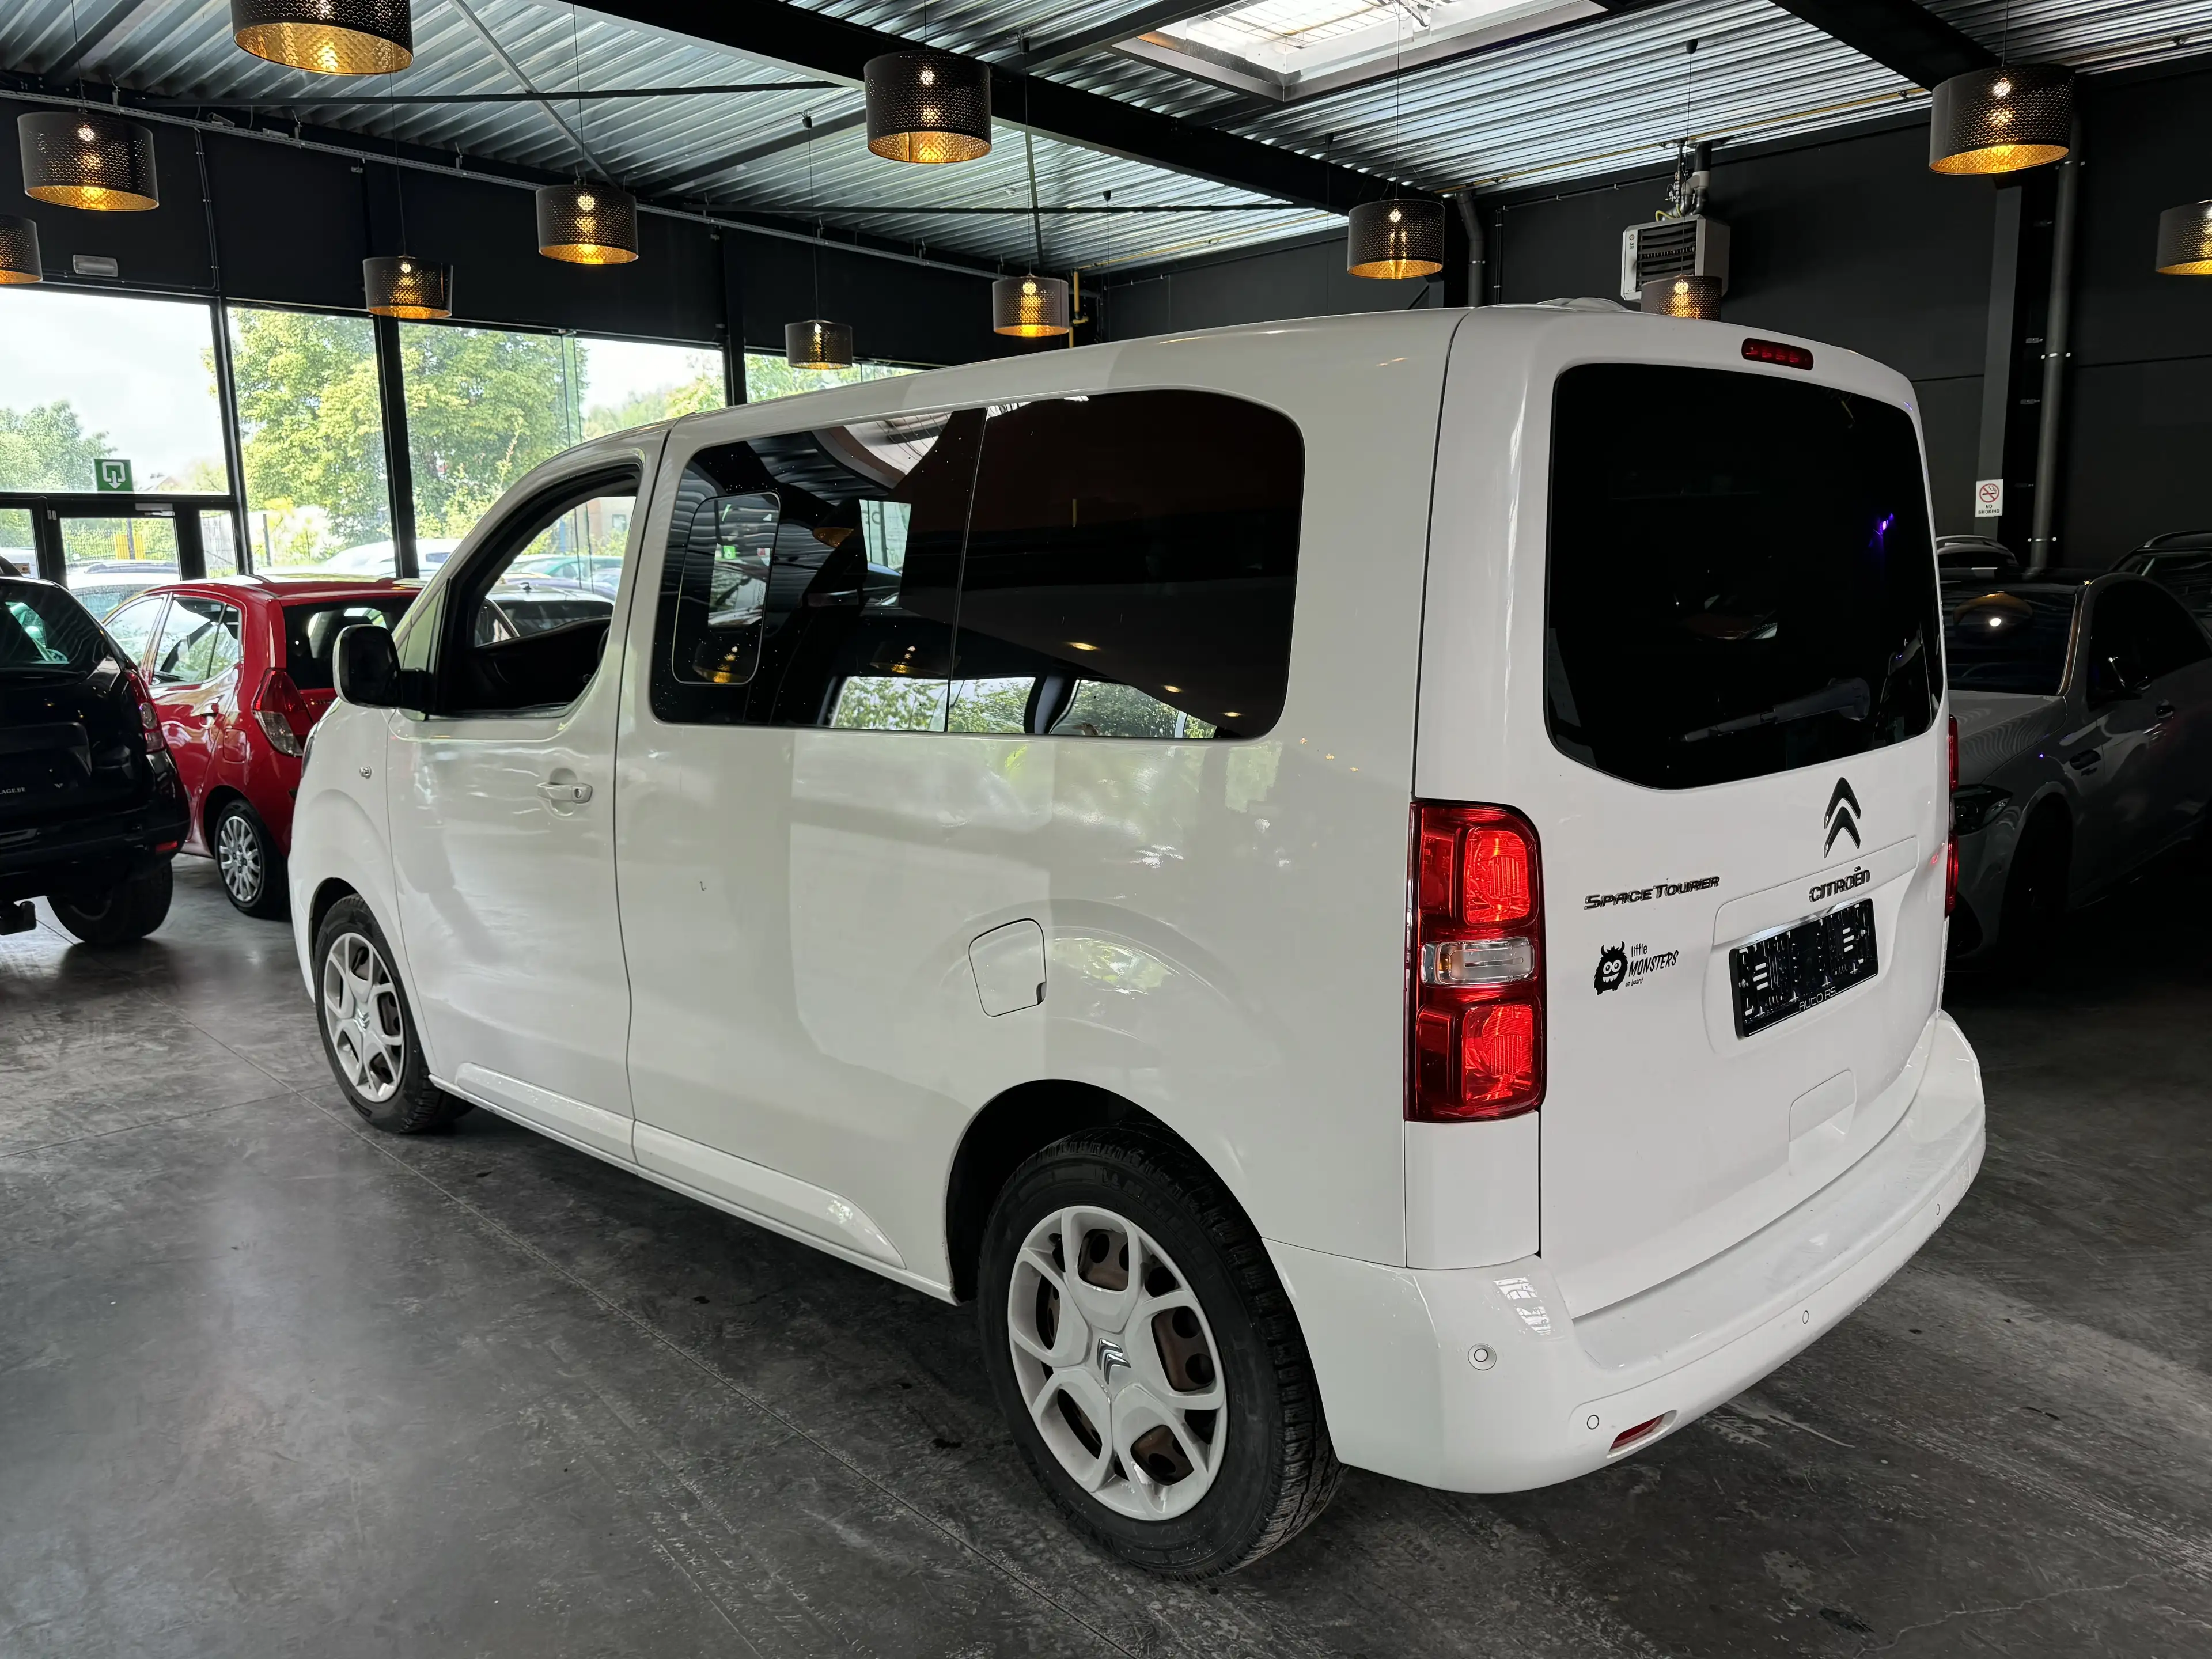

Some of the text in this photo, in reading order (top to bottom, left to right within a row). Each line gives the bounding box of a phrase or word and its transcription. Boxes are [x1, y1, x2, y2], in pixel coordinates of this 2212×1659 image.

[1631, 943, 1647, 957] little
[1628, 950, 1679, 977] MONSTERS
[1631, 977, 1643, 986] board
[1824, 986, 1837, 999] RS
